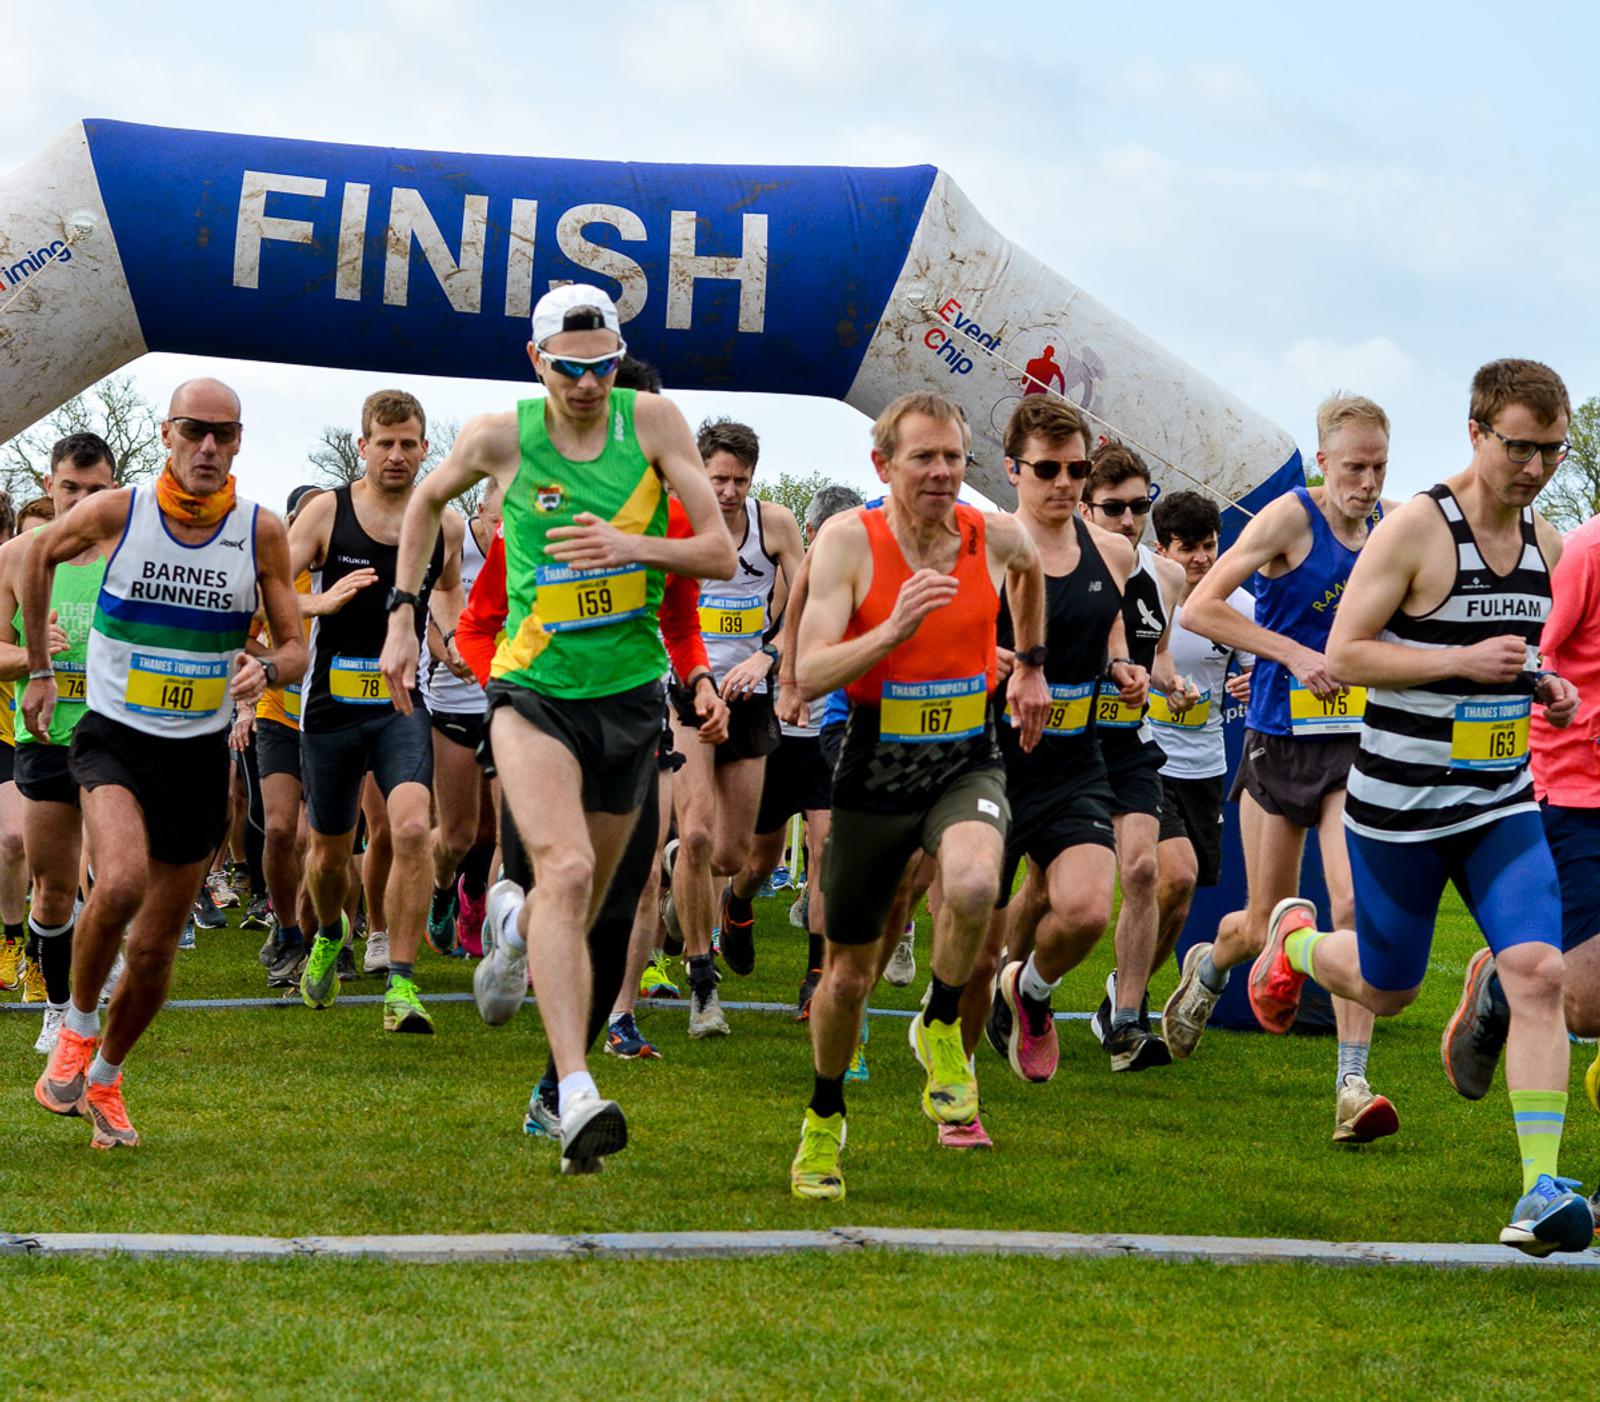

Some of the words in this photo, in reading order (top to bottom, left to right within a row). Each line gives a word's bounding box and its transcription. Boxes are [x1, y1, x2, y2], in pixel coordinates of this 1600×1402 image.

[232, 170, 768, 334] FINISH
[0, 240, 72, 291] iming
[937, 298, 1003, 356] Event
[923, 327, 974, 374] Chip
[142, 560, 228, 589] BARNES
[130, 581, 234, 610] RUNNERS
[577, 588, 613, 617] 159
[1466, 598, 1542, 618] FULHAM
[720, 616, 743, 633] 139
[139, 656, 173, 673] THAMES
[173, 662, 211, 675] TOWPATH
[212, 665, 222, 675] 10
[67, 679, 85, 697] 74
[161, 685, 194, 709] 140
[360, 679, 379, 697] 78
[891, 684, 928, 697] THAMES
[928, 681, 969, 696] TOWPATH
[970, 679, 980, 691] 10
[921, 708, 952, 733] 167
[1099, 702, 1119, 720] 29
[1464, 706, 1498, 719] THAMES
[1489, 731, 1515, 758] 163
